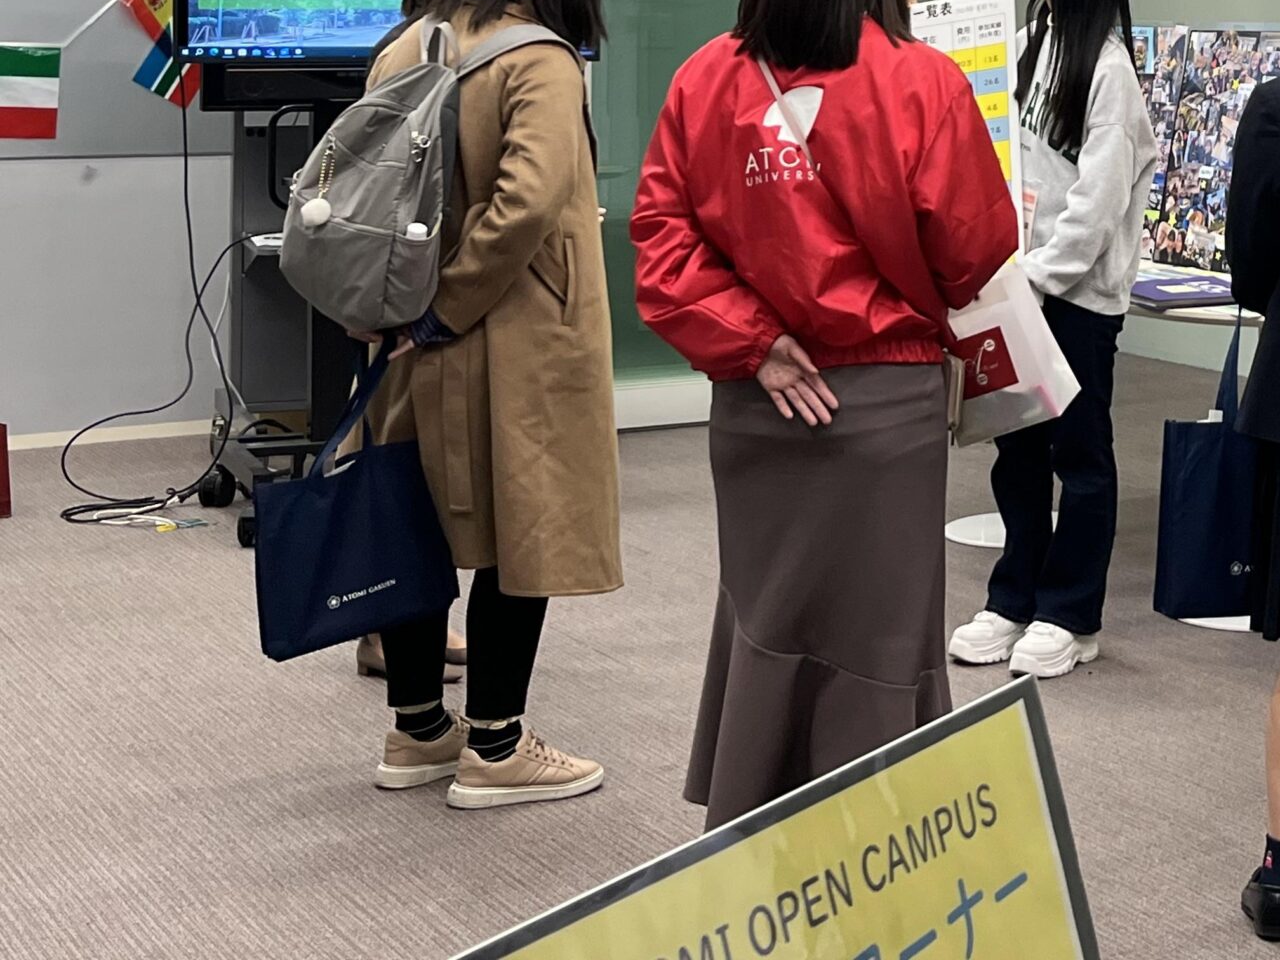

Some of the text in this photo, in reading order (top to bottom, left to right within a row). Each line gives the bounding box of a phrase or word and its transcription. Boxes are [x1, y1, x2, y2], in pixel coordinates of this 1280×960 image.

[912, 1, 952, 19] 一覧表
[342, 588, 367, 603] ATOMI
[748, 860, 854, 957] OPEN
[862, 783, 998, 892] CAMPUS
